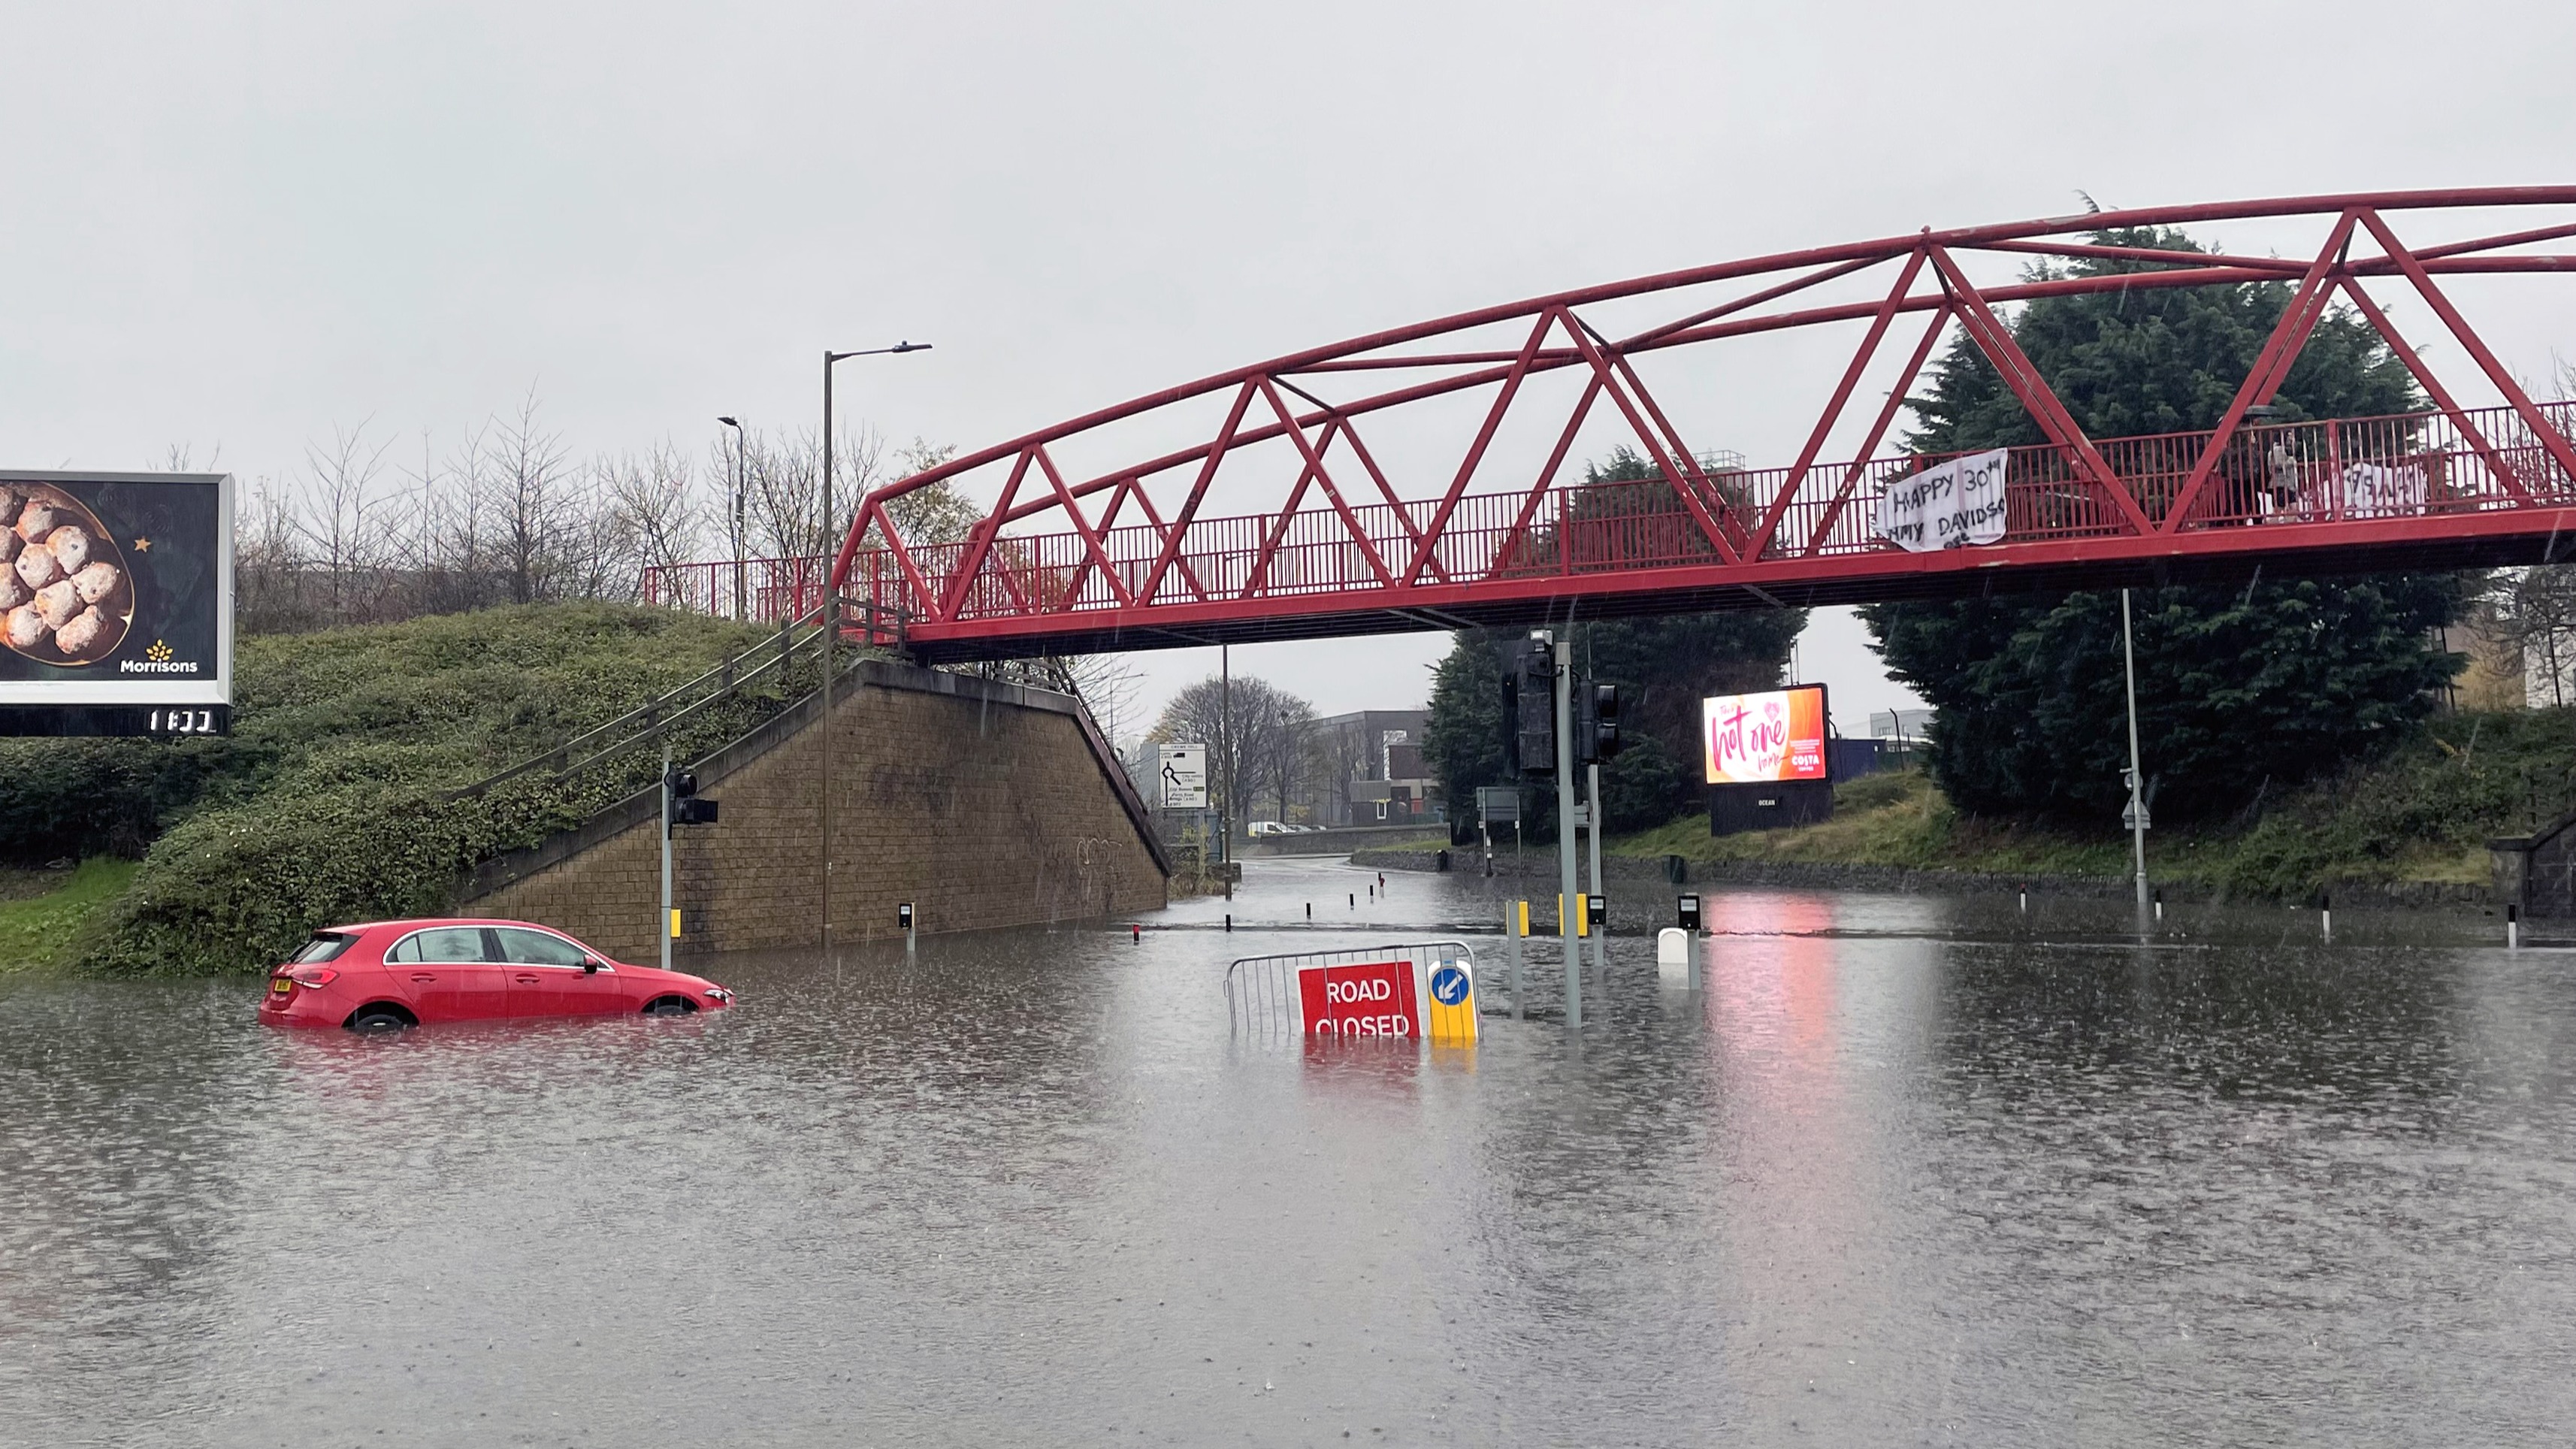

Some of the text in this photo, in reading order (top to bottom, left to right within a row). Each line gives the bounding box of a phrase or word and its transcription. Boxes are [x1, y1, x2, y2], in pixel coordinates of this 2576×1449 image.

[1894, 473, 1954, 513] HAPPY
[120, 658, 198, 673] Morrisons
[1712, 705, 1786, 771] hot one
[1791, 755, 1820, 766] COSTA
[1326, 979, 1391, 1004] ROAD
